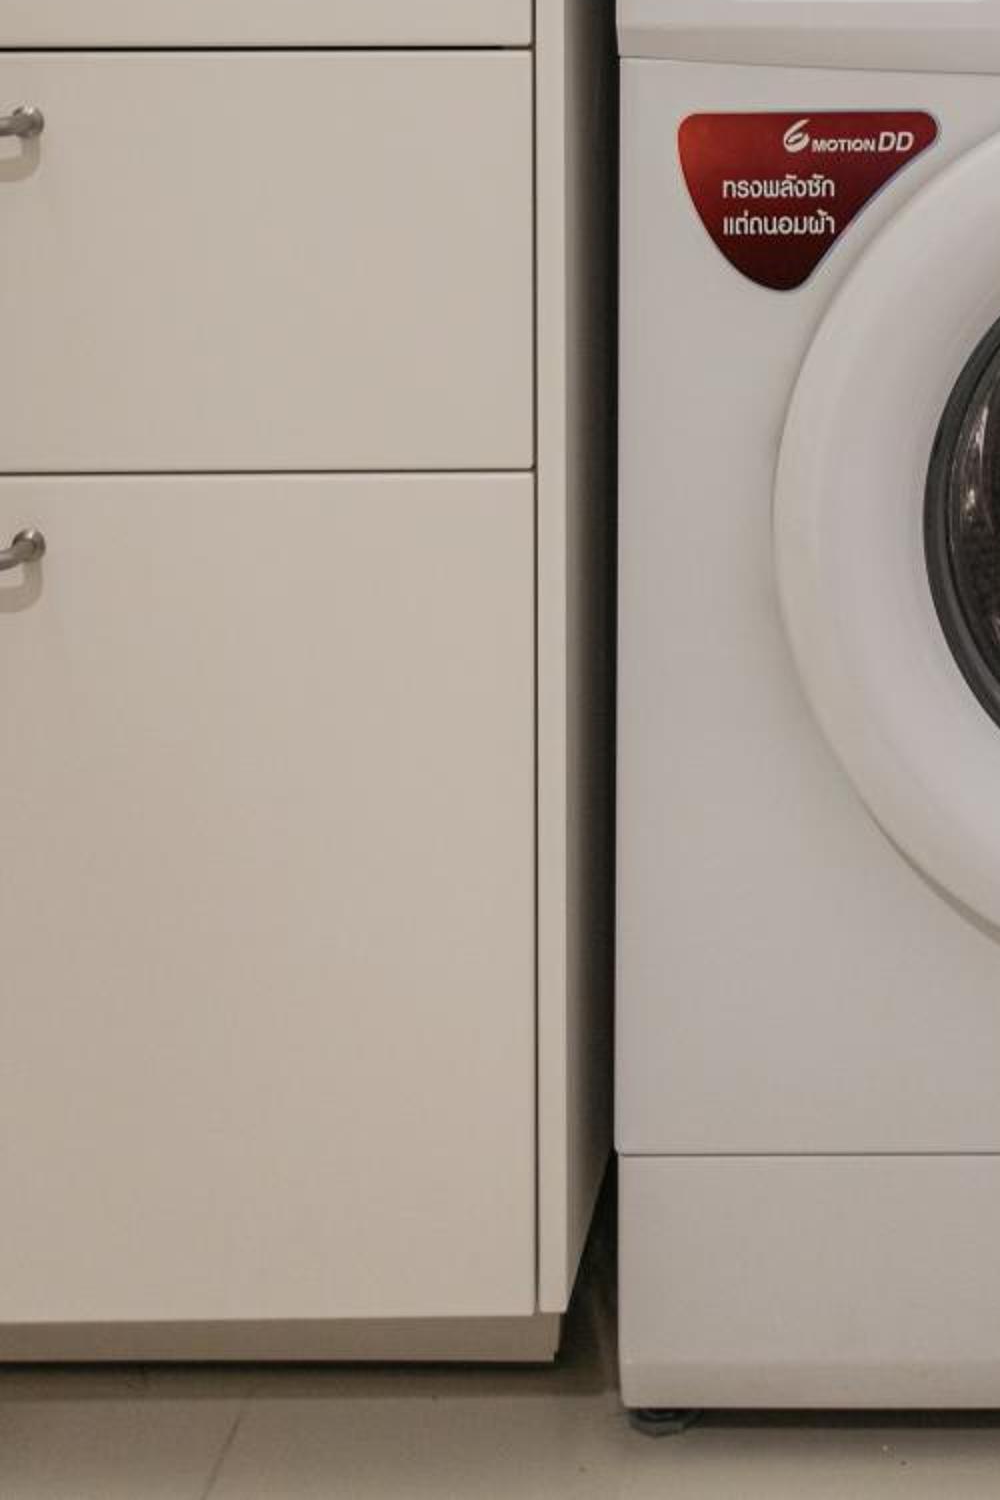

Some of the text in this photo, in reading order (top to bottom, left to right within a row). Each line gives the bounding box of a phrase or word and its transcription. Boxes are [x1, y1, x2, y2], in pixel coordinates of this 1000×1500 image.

[811, 138, 876, 152] MOTION
[877, 131, 915, 152] DD
[722, 173, 836, 199] ทรงพลังซัก
[723, 208, 836, 236] แต่ถนอมผ้า
